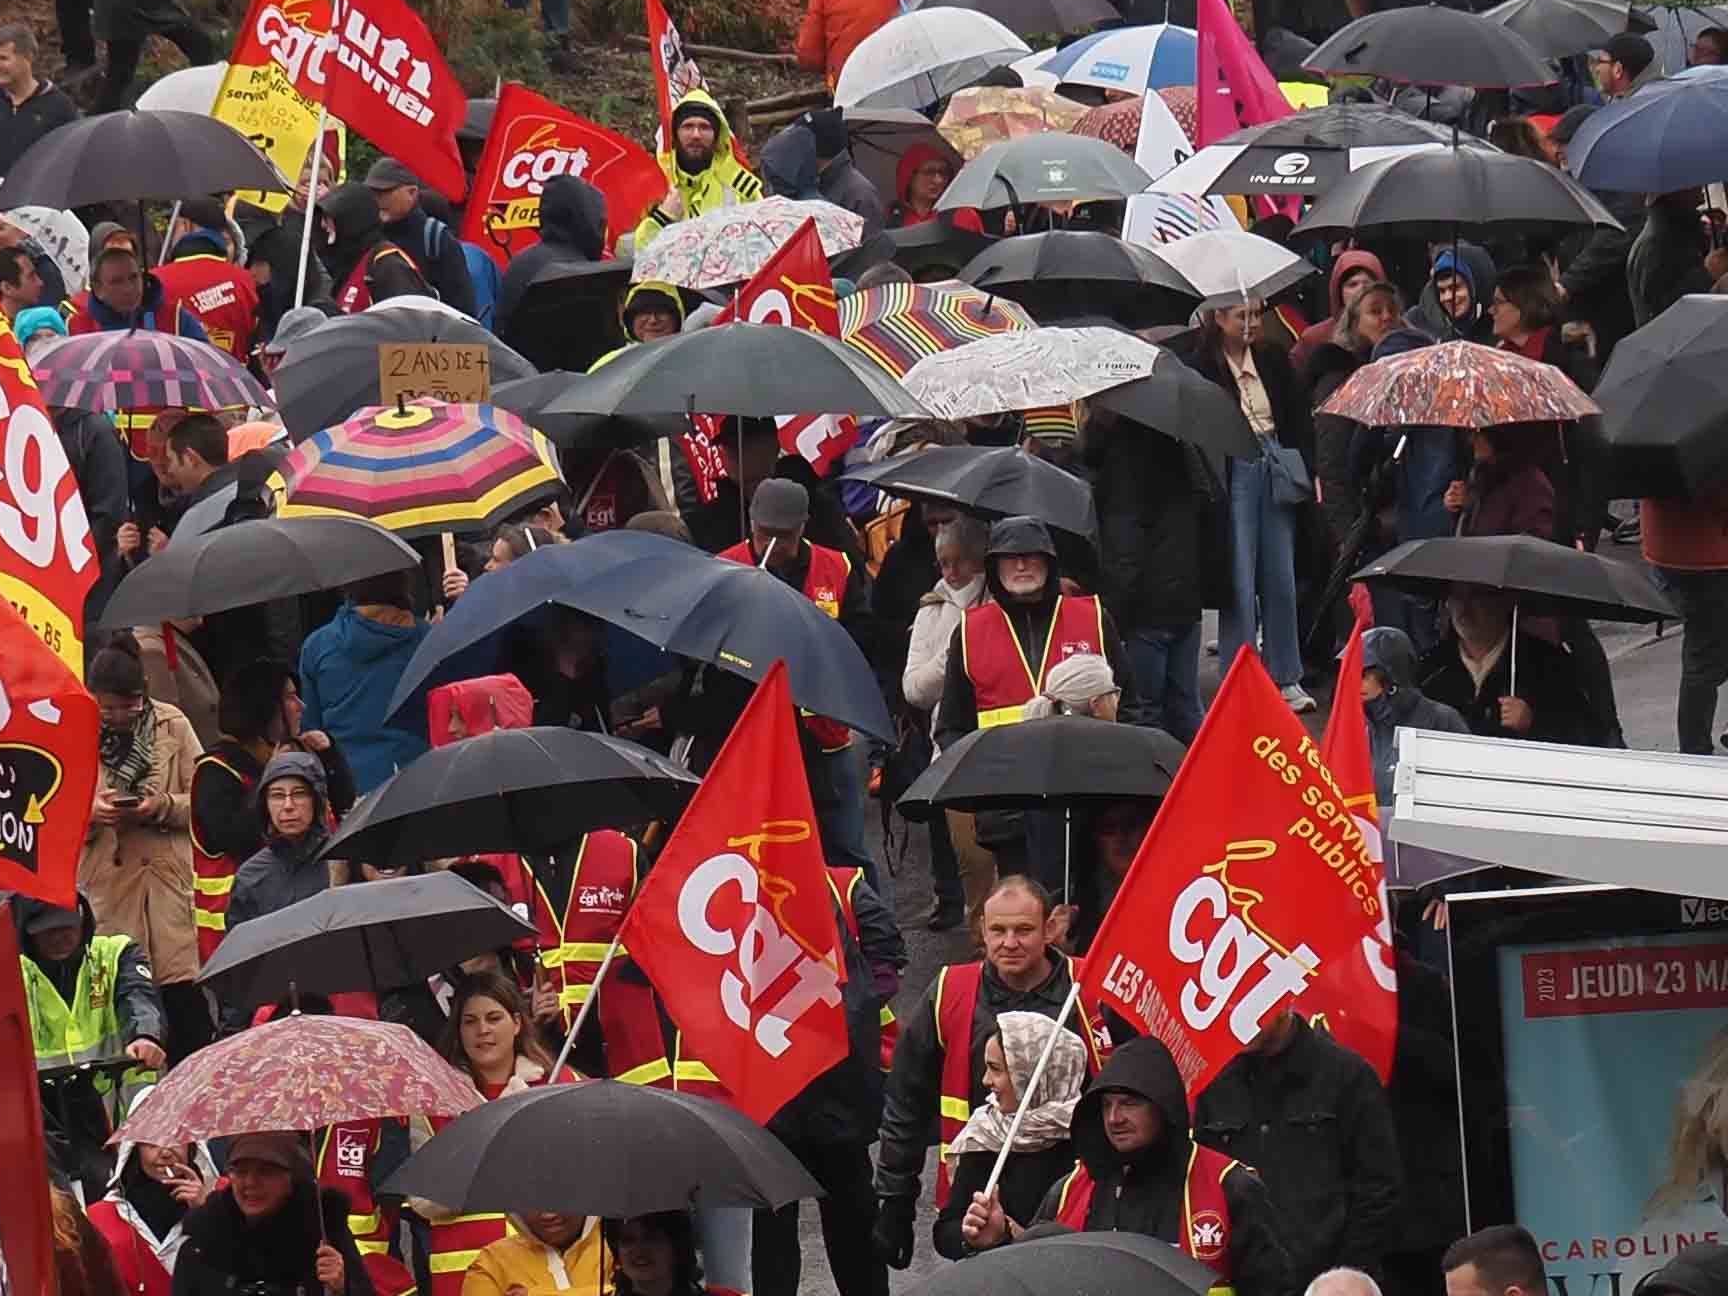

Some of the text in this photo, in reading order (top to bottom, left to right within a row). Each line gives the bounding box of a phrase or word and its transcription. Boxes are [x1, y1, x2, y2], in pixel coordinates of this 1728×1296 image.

[257, 4, 338, 84] cgt
[502, 147, 589, 194] cgt
[390, 350, 408, 376] 2
[411, 349, 449, 374] ANS
[456, 351, 473, 371] DE
[588, 509, 616, 528] cgt
[44, 621, 63, 653] 85
[1253, 736, 1302, 785] des
[1288, 817, 1379, 916] publics
[678, 854, 842, 1058] cgt
[1102, 953, 1144, 1004] LES
[1170, 877, 1321, 1045] cgt
[1539, 967, 1556, 1002] 2023
[1565, 962, 1644, 1001] JEUDI
[1655, 960, 1686, 994] 23
[339, 1145, 364, 1165] cg
